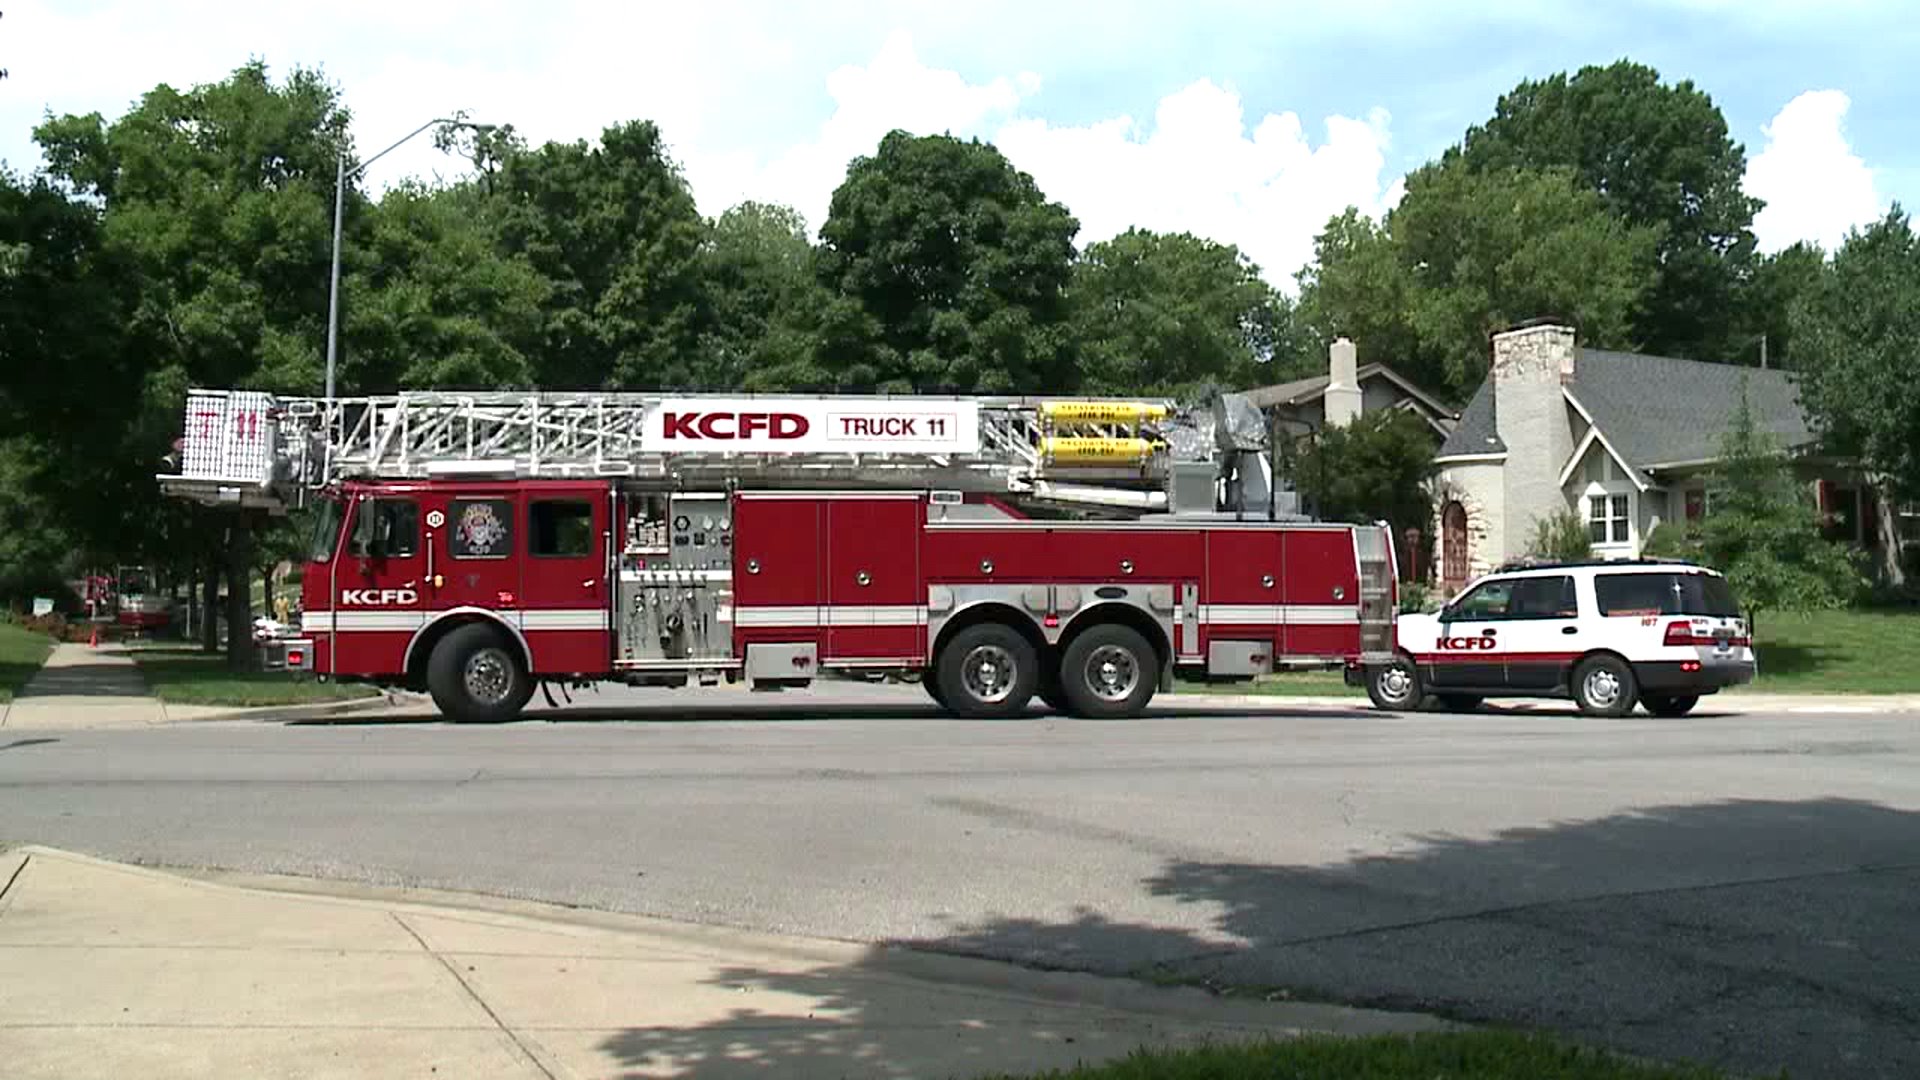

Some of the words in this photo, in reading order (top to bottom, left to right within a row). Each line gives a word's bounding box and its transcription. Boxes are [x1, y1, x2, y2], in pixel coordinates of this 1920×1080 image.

[195, 412, 217, 438] T
[663, 412, 810, 439] KCFD
[839, 417, 917, 436] TRUCK
[926, 418, 945, 436] 11
[342, 589, 418, 605] KCFD
[1436, 637, 1497, 650] KCFD
